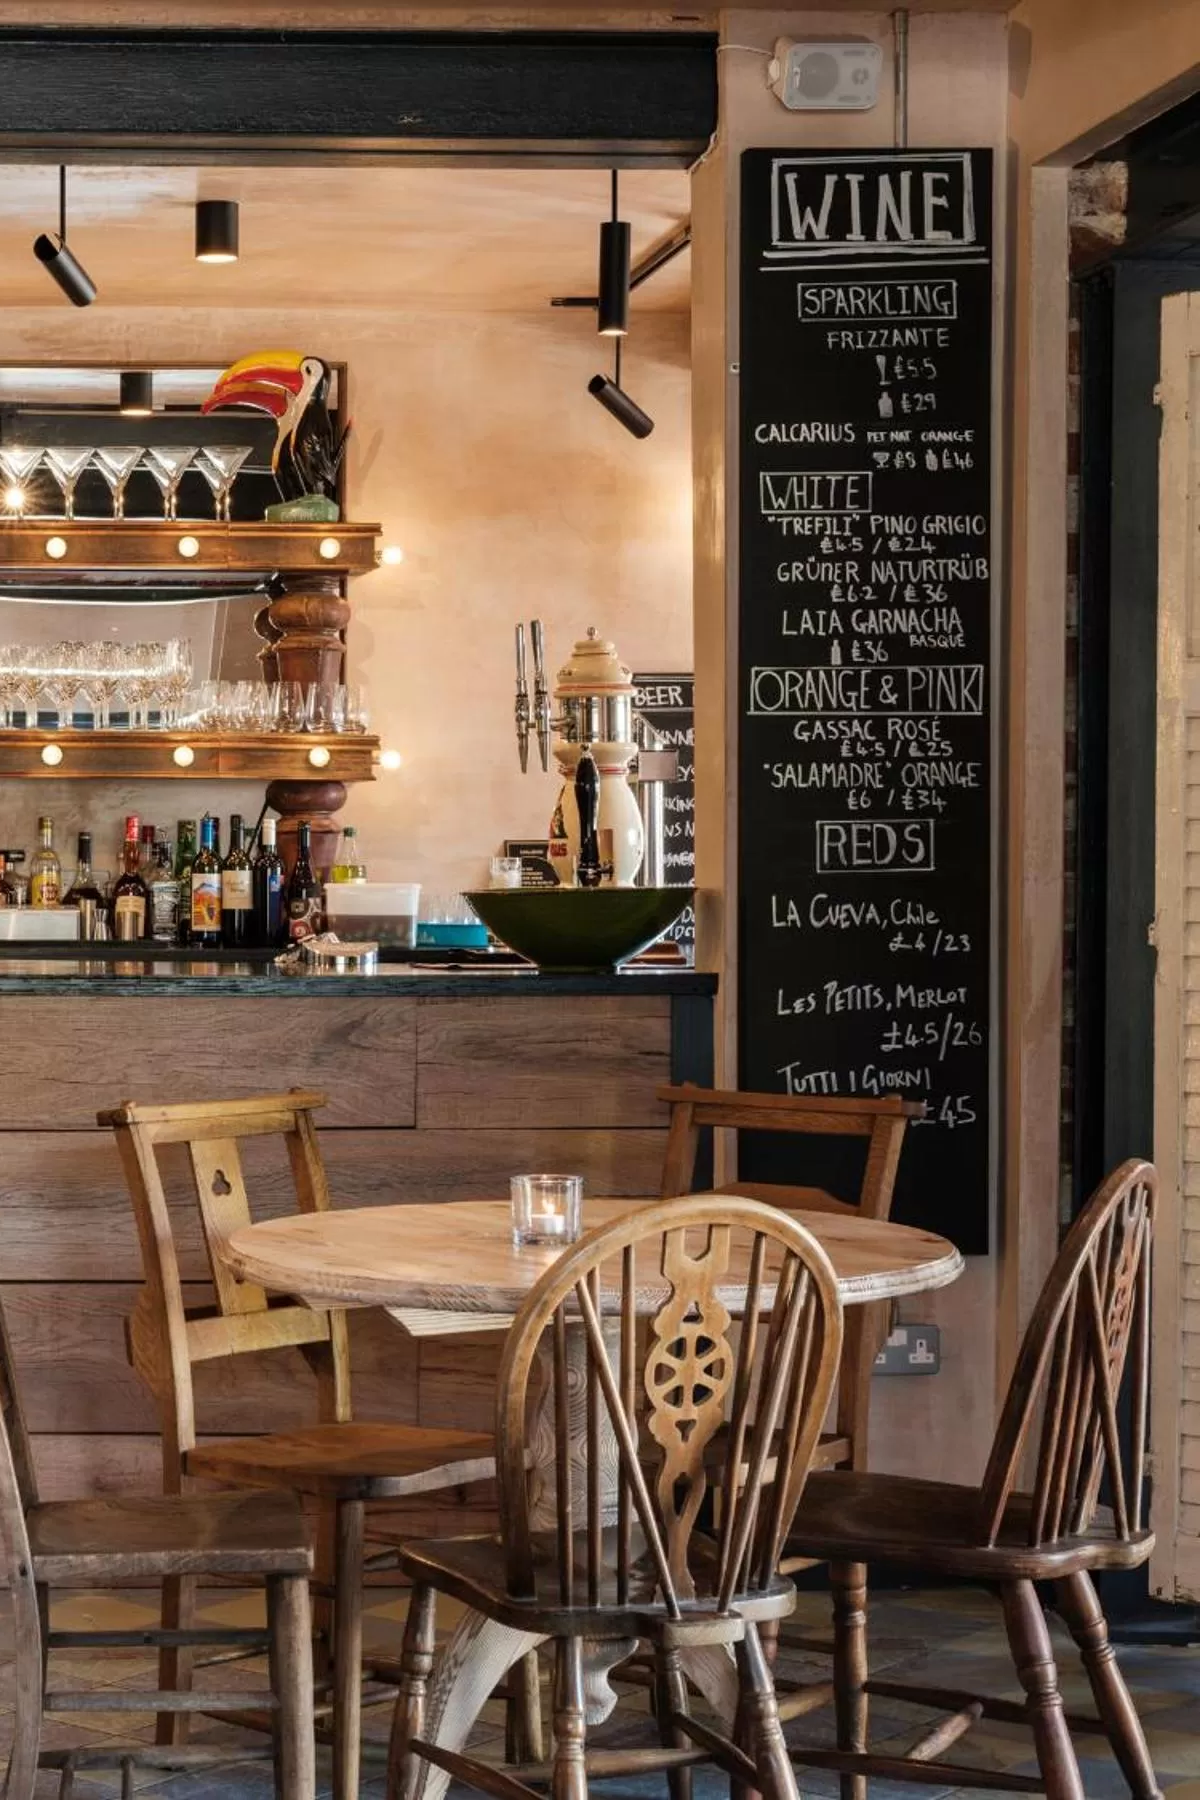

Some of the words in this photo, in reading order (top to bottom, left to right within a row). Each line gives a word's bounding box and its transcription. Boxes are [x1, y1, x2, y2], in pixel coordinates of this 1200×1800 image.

[784, 171, 953, 240] WINE
[804, 286, 951, 315] SPARKLING
[827, 328, 949, 350] FRIZZANTE
[901, 393, 937, 413] £29
[754, 422, 856, 443] CALCARIUS
[921, 430, 975, 442] ORANGE
[766, 476, 860, 509] WHITE
[870, 516, 917, 535] PINO
[922, 515, 986, 534] GRIGIO
[888, 536, 936, 553] £24
[871, 554, 989, 583] NATURTRÜB
[904, 584, 948, 603] £36
[783, 609, 844, 636] LAIA
[851, 607, 964, 635] GARNACHA
[852, 640, 888, 663] £36
[909, 635, 965, 648] BASQUE
[635, 686, 684, 706] BEER
[754, 669, 871, 711] ORANGE
[880, 675, 898, 704] &
[908, 667, 979, 711] PINK
[793, 719, 876, 742] GASSAC
[888, 716, 941, 742] ROSÉ
[901, 762, 981, 788] ORANGE
[847, 789, 871, 810] £6
[901, 788, 947, 813] £34
[823, 823, 925, 866] REDS
[772, 895, 801, 928] LA
[809, 894, 888, 929] CUEVA,
[890, 899, 940, 926] Chile
[896, 984, 967, 1009] MERLOT
[777, 1062, 838, 1096] TUTTI
[862, 1065, 931, 1094] GIORNI
[911, 1096, 977, 1128] £45
